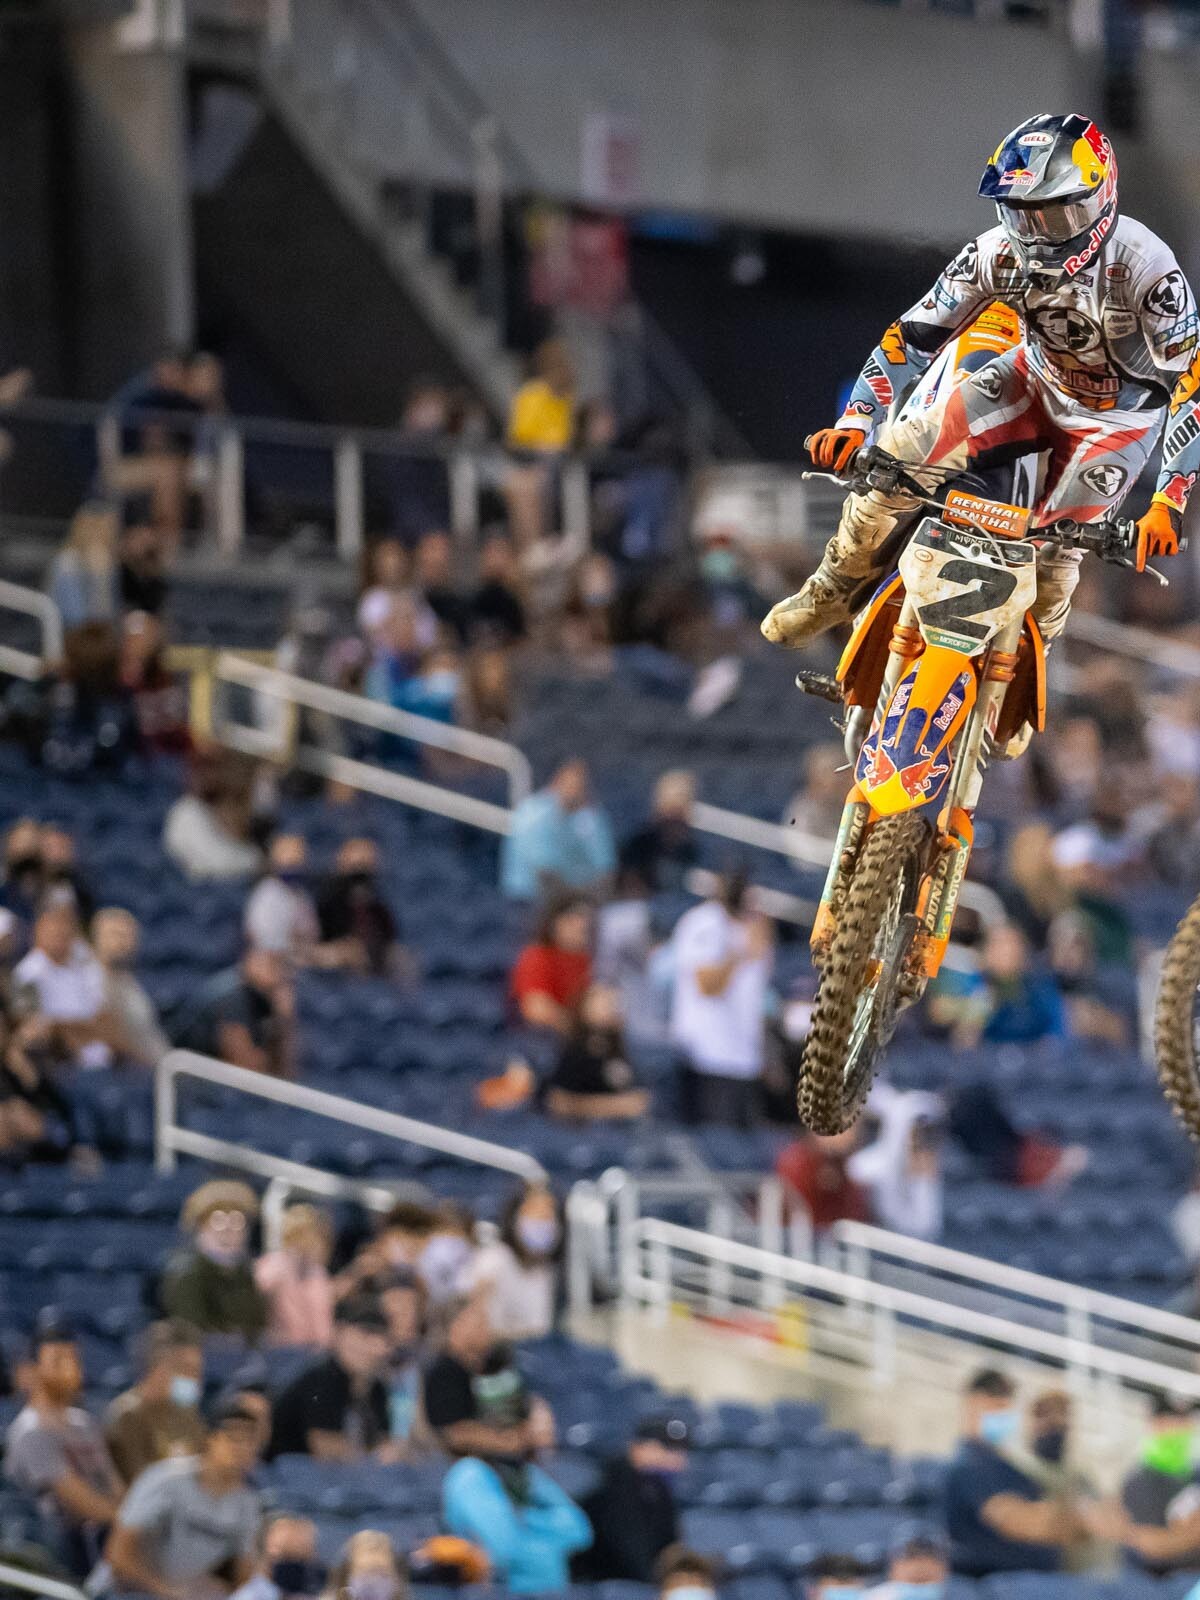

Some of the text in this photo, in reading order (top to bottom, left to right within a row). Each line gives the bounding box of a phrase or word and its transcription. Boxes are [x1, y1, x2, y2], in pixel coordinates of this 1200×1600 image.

[1023, 135, 1048, 144] BELL
[951, 496, 1021, 520] RENTHAL
[917, 559, 1018, 640] 2
